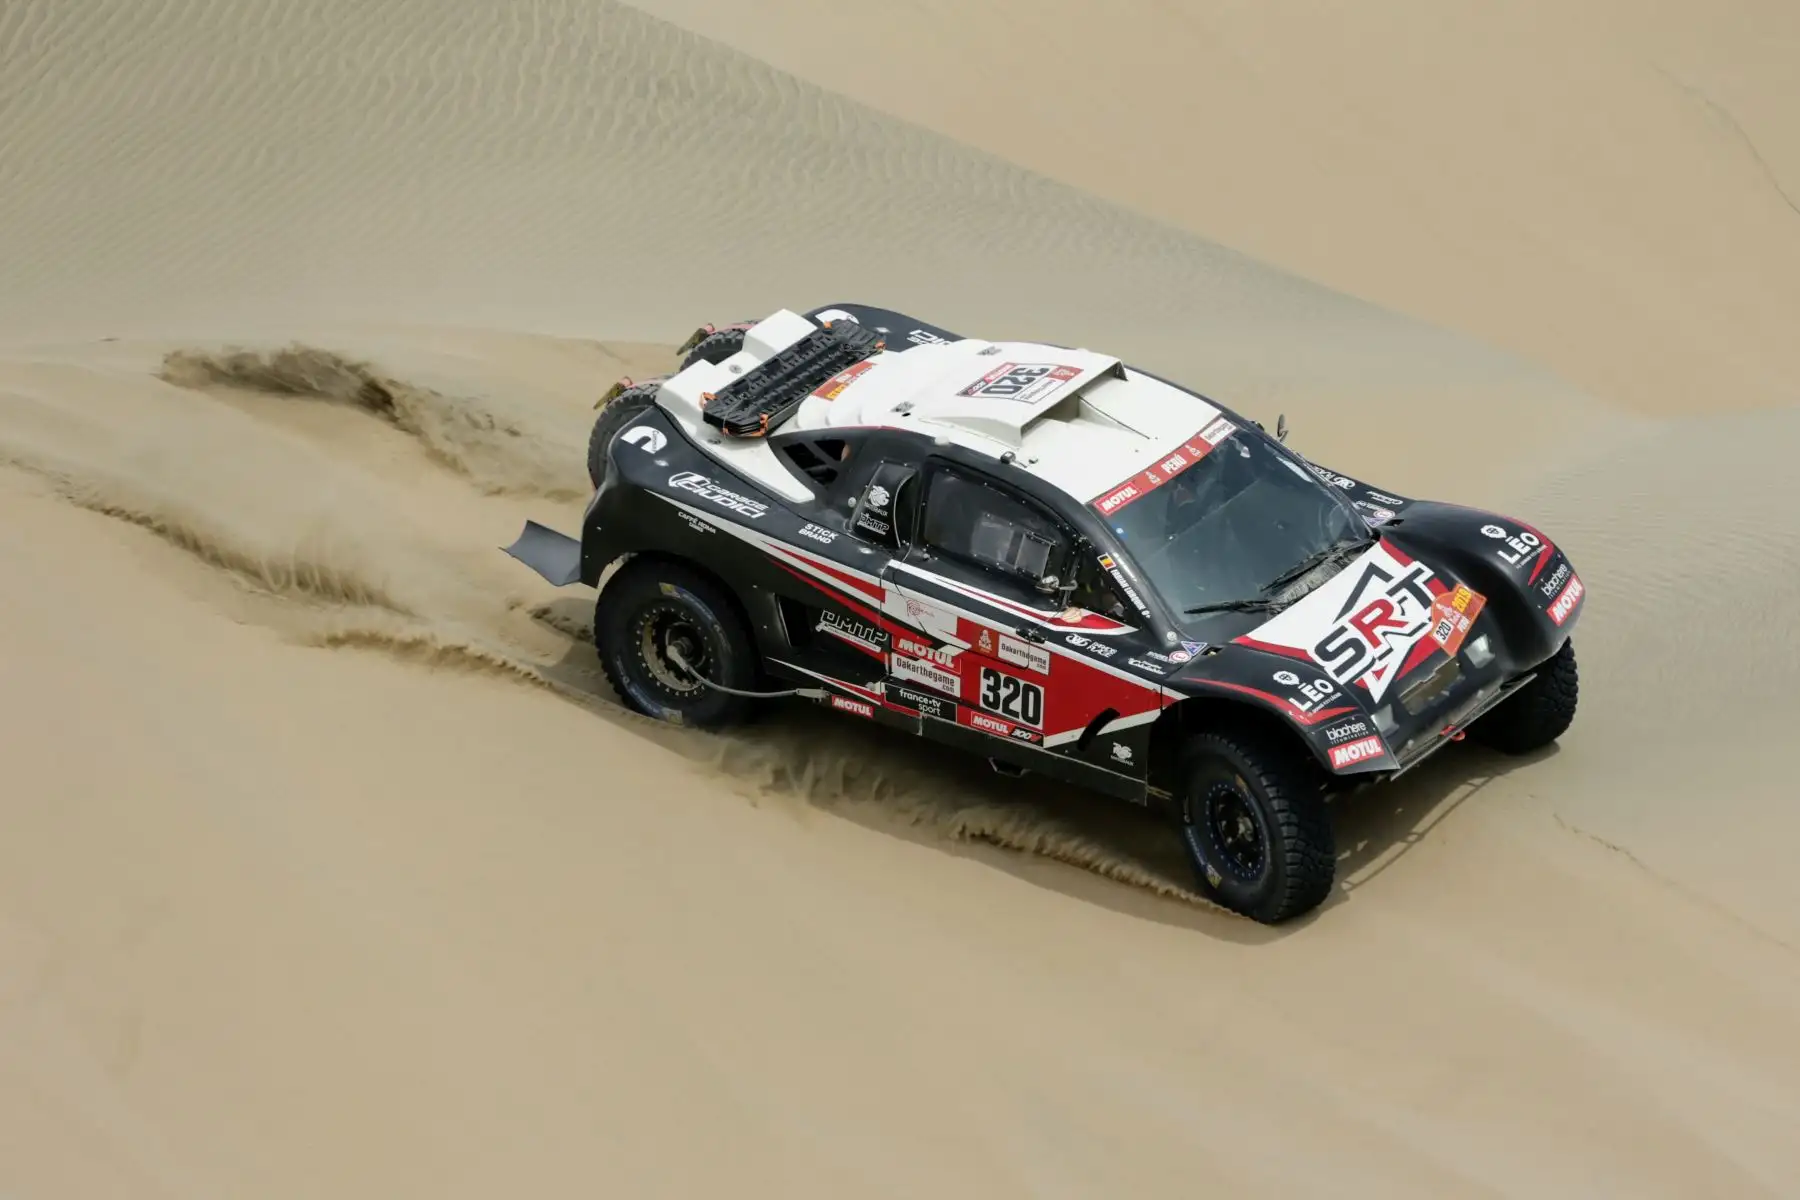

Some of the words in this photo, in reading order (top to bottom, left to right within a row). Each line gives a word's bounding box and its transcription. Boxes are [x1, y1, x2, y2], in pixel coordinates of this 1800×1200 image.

[981, 367, 1050, 395] 320
[1101, 486, 1137, 511] MOTUL
[798, 528, 832, 544] BRAND
[804, 523, 839, 540] STICK
[1552, 578, 1583, 622] MOTUL
[1314, 566, 1436, 679] SRT
[1436, 621, 1452, 641] 320
[898, 638, 955, 668] MOTUL
[896, 657, 955, 687] Dakarthegame
[833, 697, 872, 717] MOTUL
[982, 667, 1042, 726] 320
[918, 703, 941, 716] sport
[973, 715, 1009, 734] MOTUL
[1334, 739, 1382, 765] MOTUL
